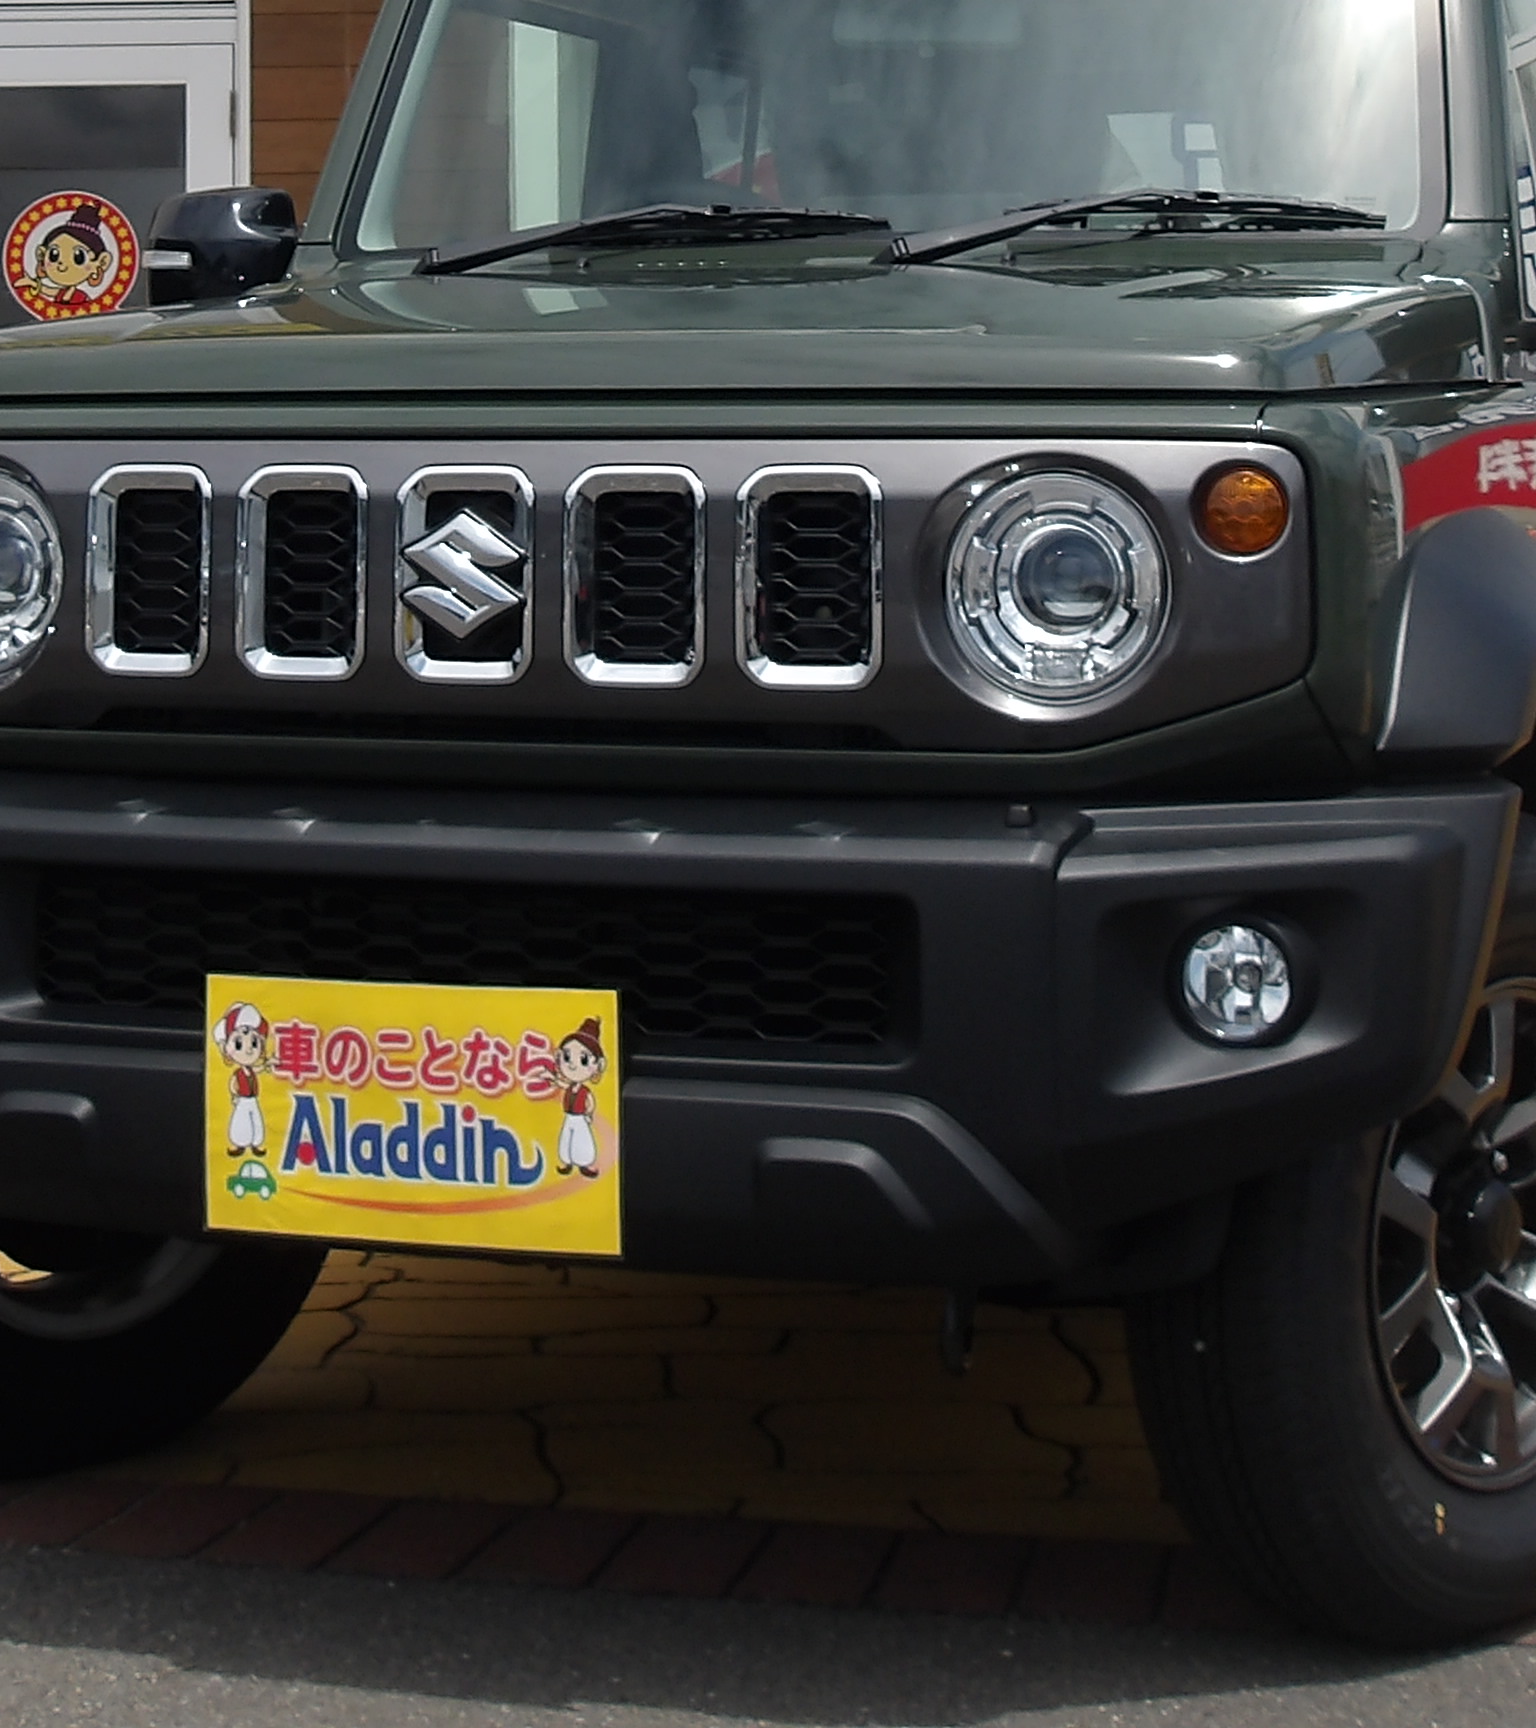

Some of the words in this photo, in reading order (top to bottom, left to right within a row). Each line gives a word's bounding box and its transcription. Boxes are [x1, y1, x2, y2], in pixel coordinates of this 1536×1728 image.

[273, 1020, 561, 1097] 車のことなら
[280, 1094, 544, 1186] Aladdin
